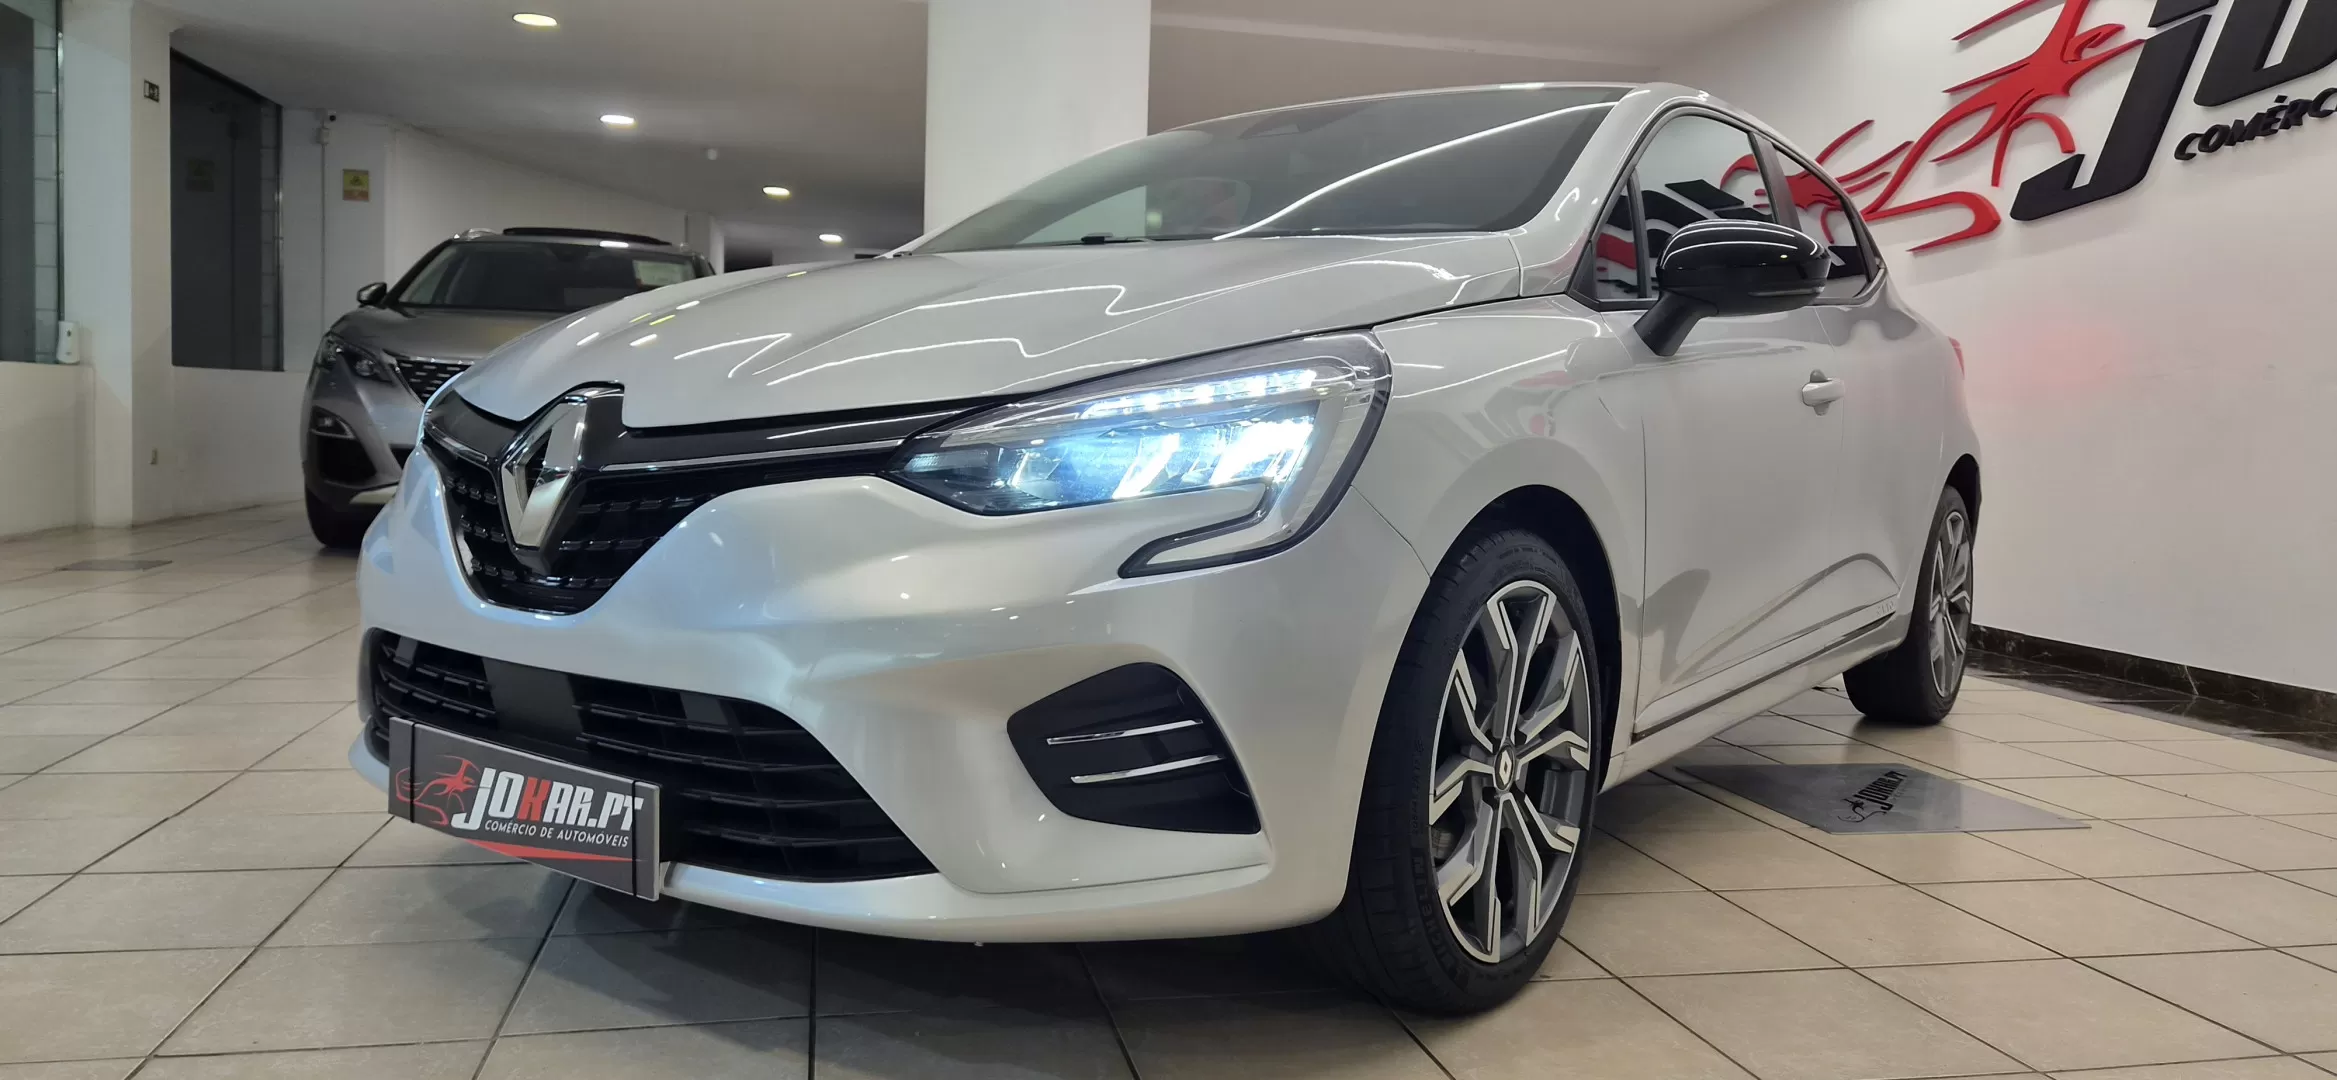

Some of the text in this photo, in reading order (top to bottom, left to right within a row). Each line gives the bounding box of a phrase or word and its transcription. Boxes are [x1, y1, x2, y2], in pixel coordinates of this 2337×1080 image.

[2174, 87, 2337, 161] COMÉRC
[484, 819, 630, 848] COMÉRCIO DE AUTOMÓVEIS
